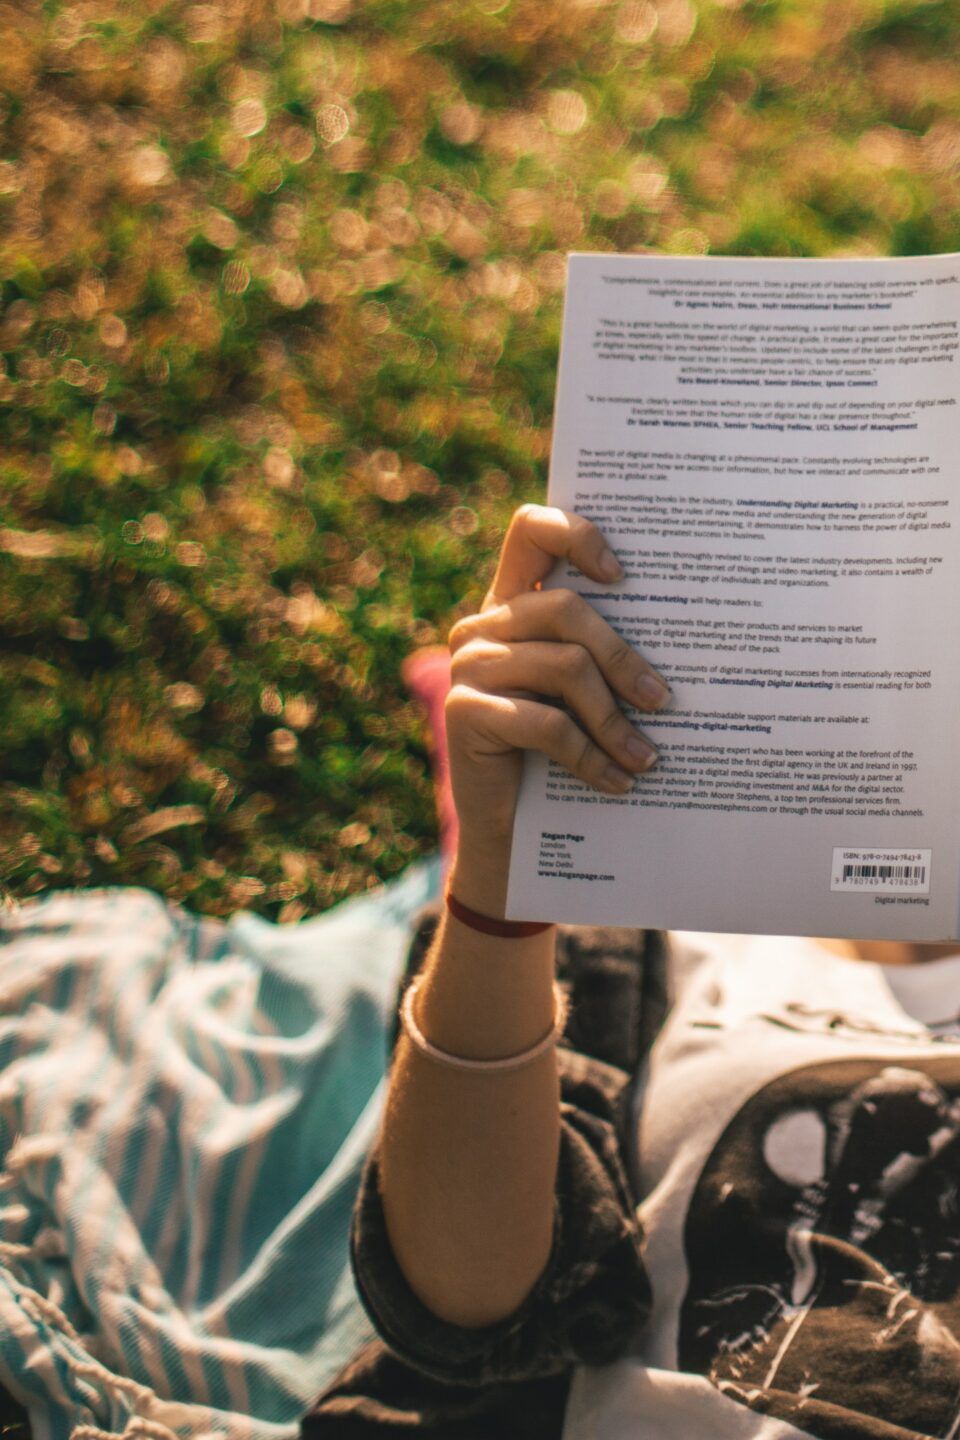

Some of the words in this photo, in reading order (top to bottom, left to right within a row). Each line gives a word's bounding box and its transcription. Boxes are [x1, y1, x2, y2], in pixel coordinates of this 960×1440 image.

[643, 639, 660, 649] edge
[673, 641, 690, 651] keep
[693, 642, 712, 650] them
[715, 643, 737, 651] ahead
[763, 645, 780, 655] pack
[671, 743, 685, 752] and
[687, 744, 724, 755] marketing
[727, 746, 750, 756] expert
[752, 747, 768, 755] who
[770, 748, 783, 756] has
[806, 749, 835, 759] working
[846, 750, 858, 758] the
[859, 750, 890, 758] forefront
[675, 754, 685, 762] He
[688, 755, 729, 765] established
[731, 757, 744, 765] the
[745, 758, 760, 766] first
[762, 759, 785, 769] digital
[788, 761, 812, 770] agency
[824, 761, 836, 769] the
[838, 761, 848, 769] UK
[866, 762, 890, 770] Ireland
[660, 766, 687, 774] finance
[705, 768, 729, 778] digital
[731, 769, 753, 777] media
[755, 770, 791, 781] specialist.
[822, 773, 860, 783] previously
[867, 774, 893, 784] partner
[665, 777, 696, 788] advisory
[698, 779, 713, 787] firm
[715, 780, 751, 791] providing
[753, 782, 794, 791] investment
[796, 783, 810, 791] and
[812, 784, 830, 792] M&A
[832, 784, 842, 792] for
[858, 785, 880, 794] digital
[882, 785, 904, 793] sector.
[546, 793, 560, 801] You
[577, 795, 597, 803] reach
[599, 796, 629, 806] Damian
[780, 806, 808, 816] through
[825, 807, 844, 815] usual
[846, 808, 866, 816] social
[868, 808, 890, 816] media
[662, 788, 690, 797] Partner
[692, 790, 708, 798] with
[710, 791, 734, 800] Moore
[781, 794, 794, 804] top
[809, 795, 853, 805] professional
[855, 796, 883, 804] services
[542, 832, 566, 841] Kogan
[566, 834, 585, 842] Page
[540, 850, 555, 858] New
[538, 870, 615, 881] www.koganpage.com
[875, 896, 896, 905] Digital
[897, 897, 929, 906] marketing
